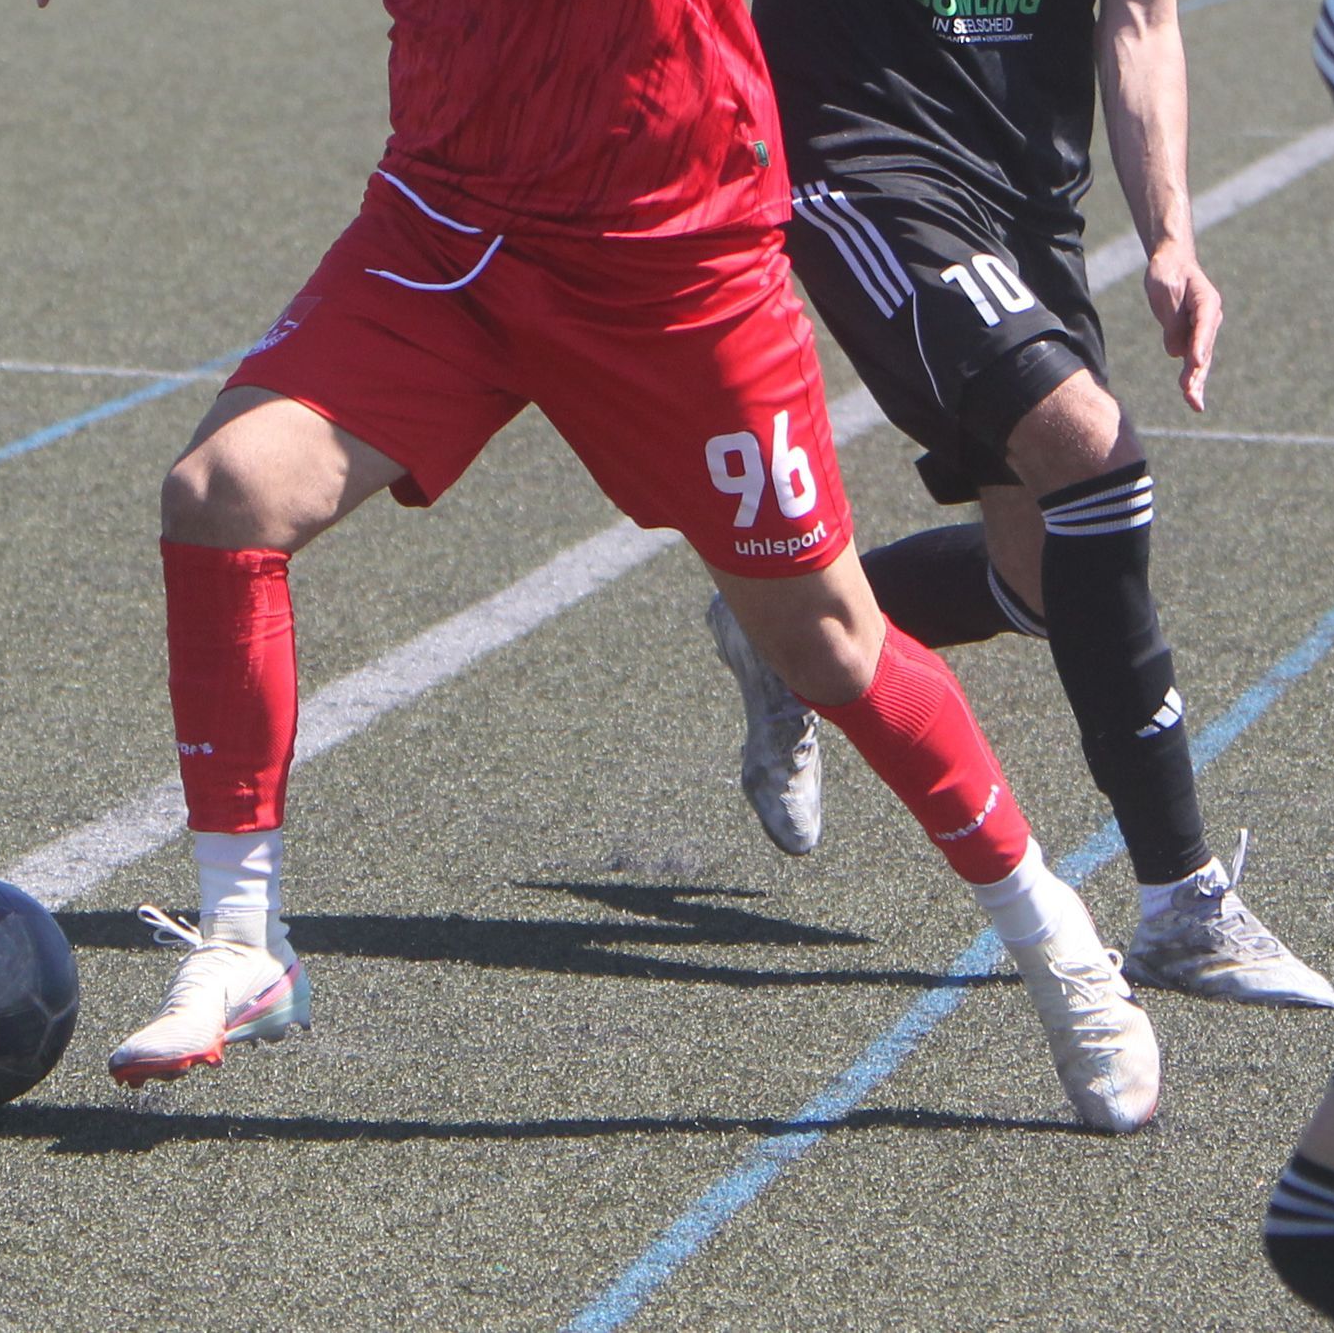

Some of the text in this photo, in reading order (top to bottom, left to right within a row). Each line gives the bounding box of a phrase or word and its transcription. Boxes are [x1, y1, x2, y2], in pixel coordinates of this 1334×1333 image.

[931, 15, 1014, 35] IN SEELSCHEID
[939, 253, 1037, 328] 10
[704, 409, 818, 529] 96
[734, 520, 828, 559] uhlsport
